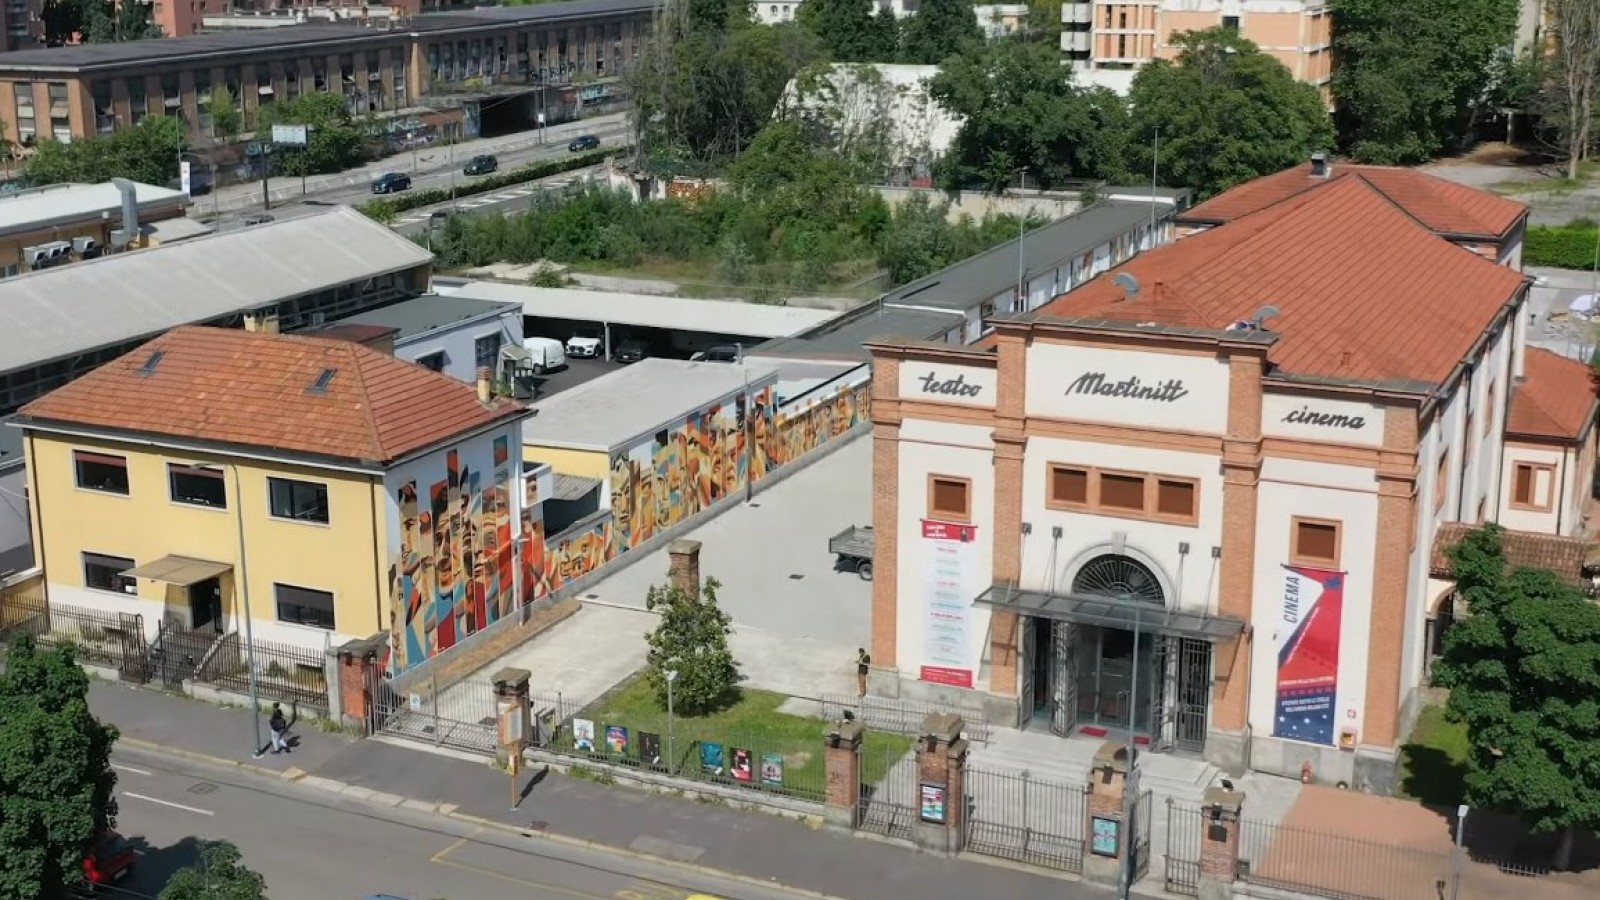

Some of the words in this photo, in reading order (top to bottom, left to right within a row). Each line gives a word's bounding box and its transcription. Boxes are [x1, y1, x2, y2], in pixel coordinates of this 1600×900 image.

[918, 374, 982, 397] teatro
[1065, 372, 1189, 402] Martinitt
[1281, 407, 1366, 430] cinema
[1283, 576, 1299, 623] CINEMA
